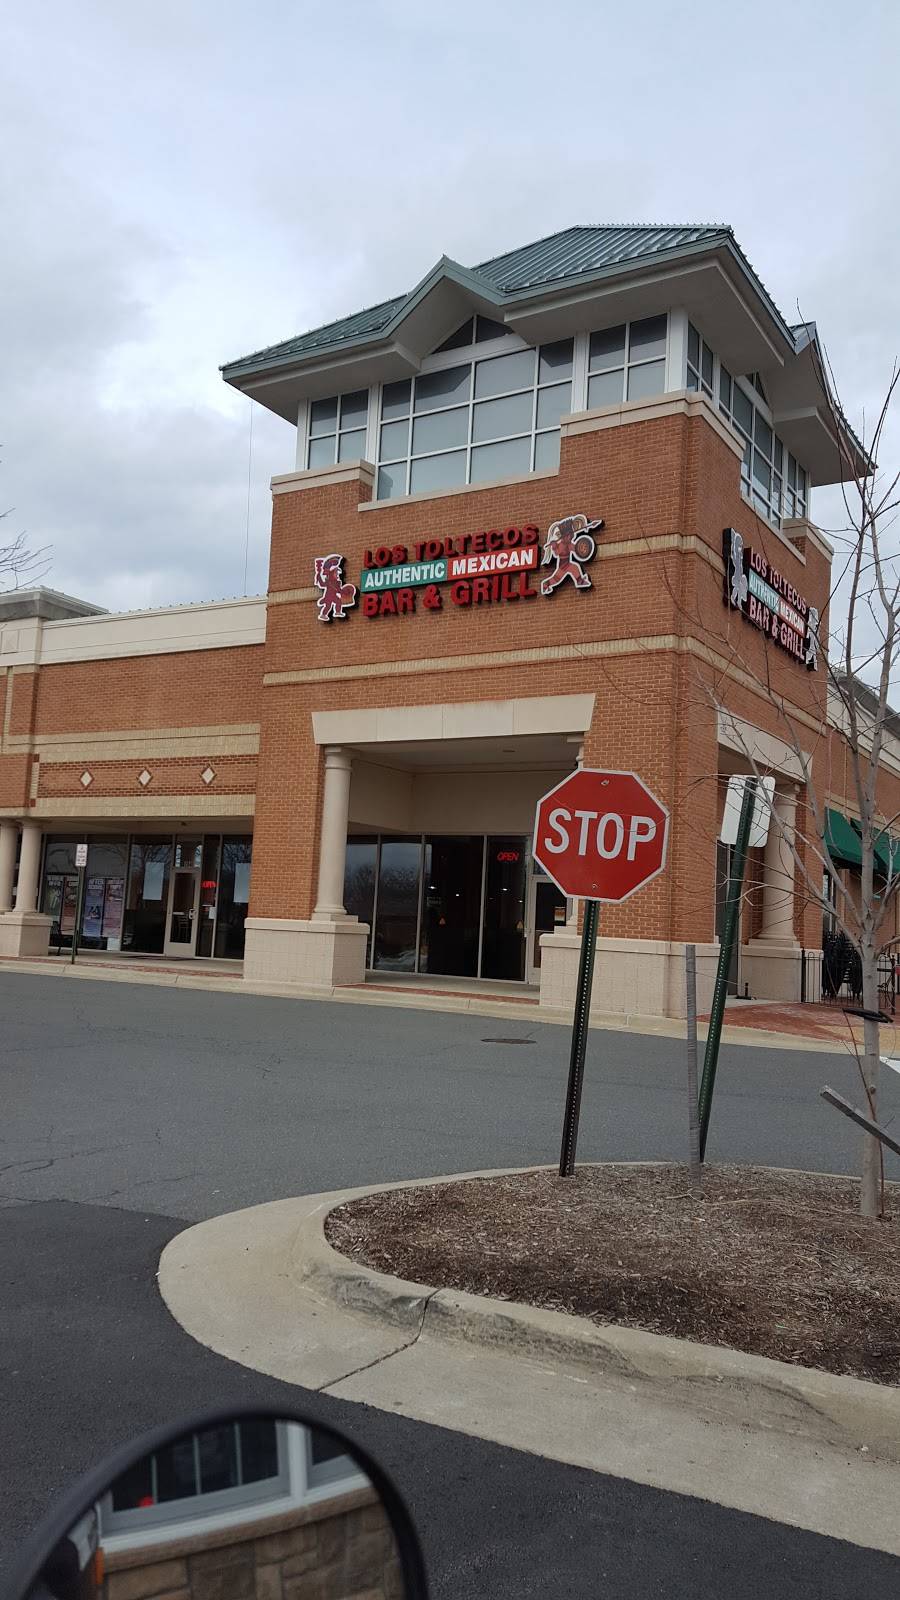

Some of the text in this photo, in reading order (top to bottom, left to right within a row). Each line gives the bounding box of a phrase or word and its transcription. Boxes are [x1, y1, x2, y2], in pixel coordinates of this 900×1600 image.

[363, 523, 540, 568] LOS TOLTECOS
[750, 547, 767, 578] LOS
[365, 549, 533, 588] AUTHENTIC MEXICAN
[363, 572, 537, 618] BAR & GRILL
[750, 595, 805, 660] BAR & GRILL
[497, 851, 519, 861] OPEN
[544, 808, 657, 861] STOP
